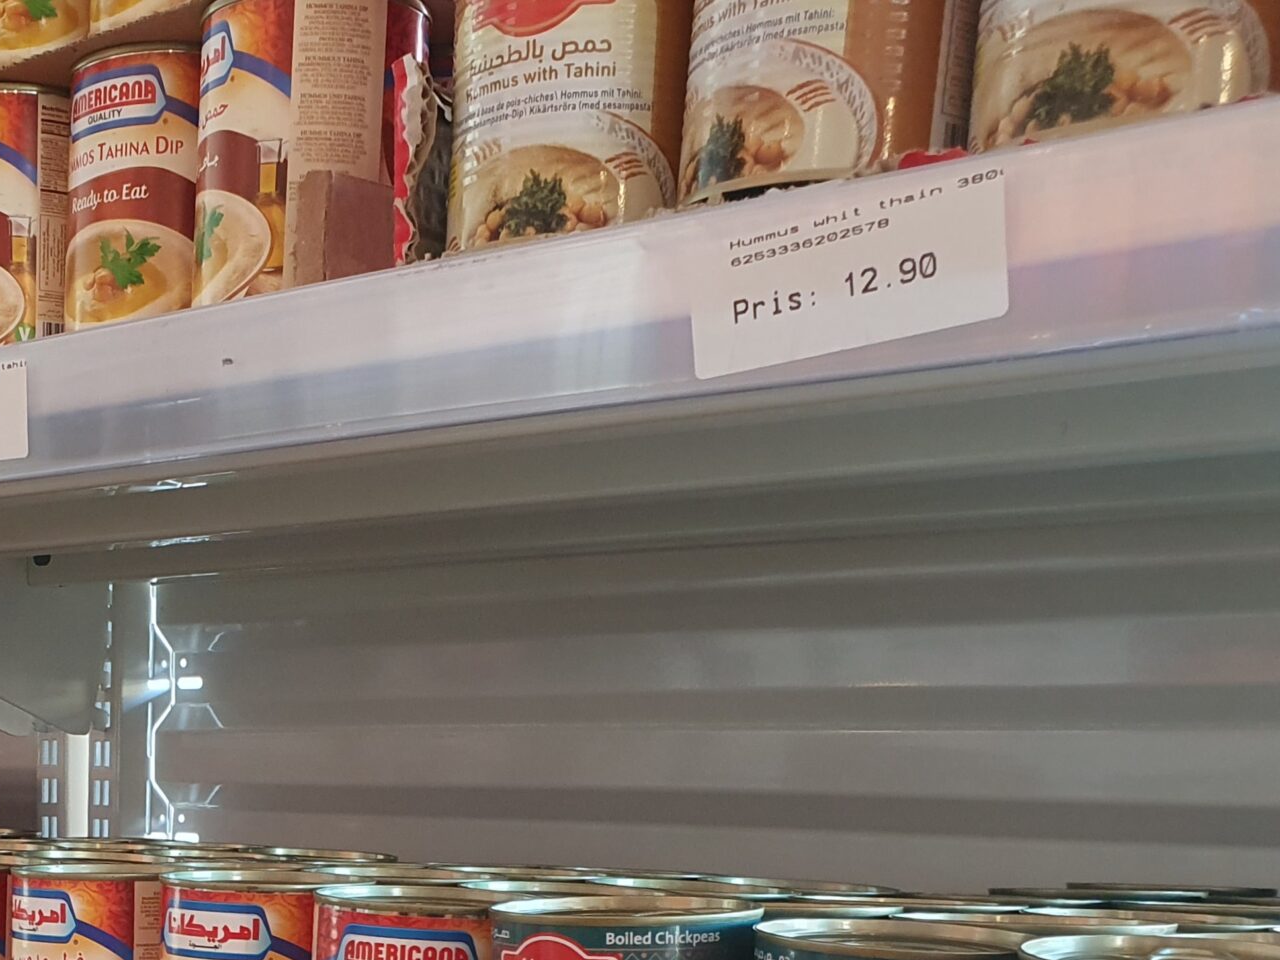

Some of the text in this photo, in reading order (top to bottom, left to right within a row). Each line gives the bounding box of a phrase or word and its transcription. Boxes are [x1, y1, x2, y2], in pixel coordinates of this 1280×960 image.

[551, 37, 613, 61] حمص
[523, 61, 617, 85] with Tahini
[72, 80, 157, 120] AMERICANA
[560, 88, 615, 100] Hommus mit
[87, 108, 123, 126] QUALITY
[97, 135, 184, 162] TAHINA DIP
[72, 183, 150, 215] Ready to Eat
[729, 187, 944, 251] Hummus whit thain
[730, 218, 890, 268] 6253336202578
[732, 252, 937, 324] Pris: 12.90
[605, 930, 721, 948] Boiled Chickpeas
